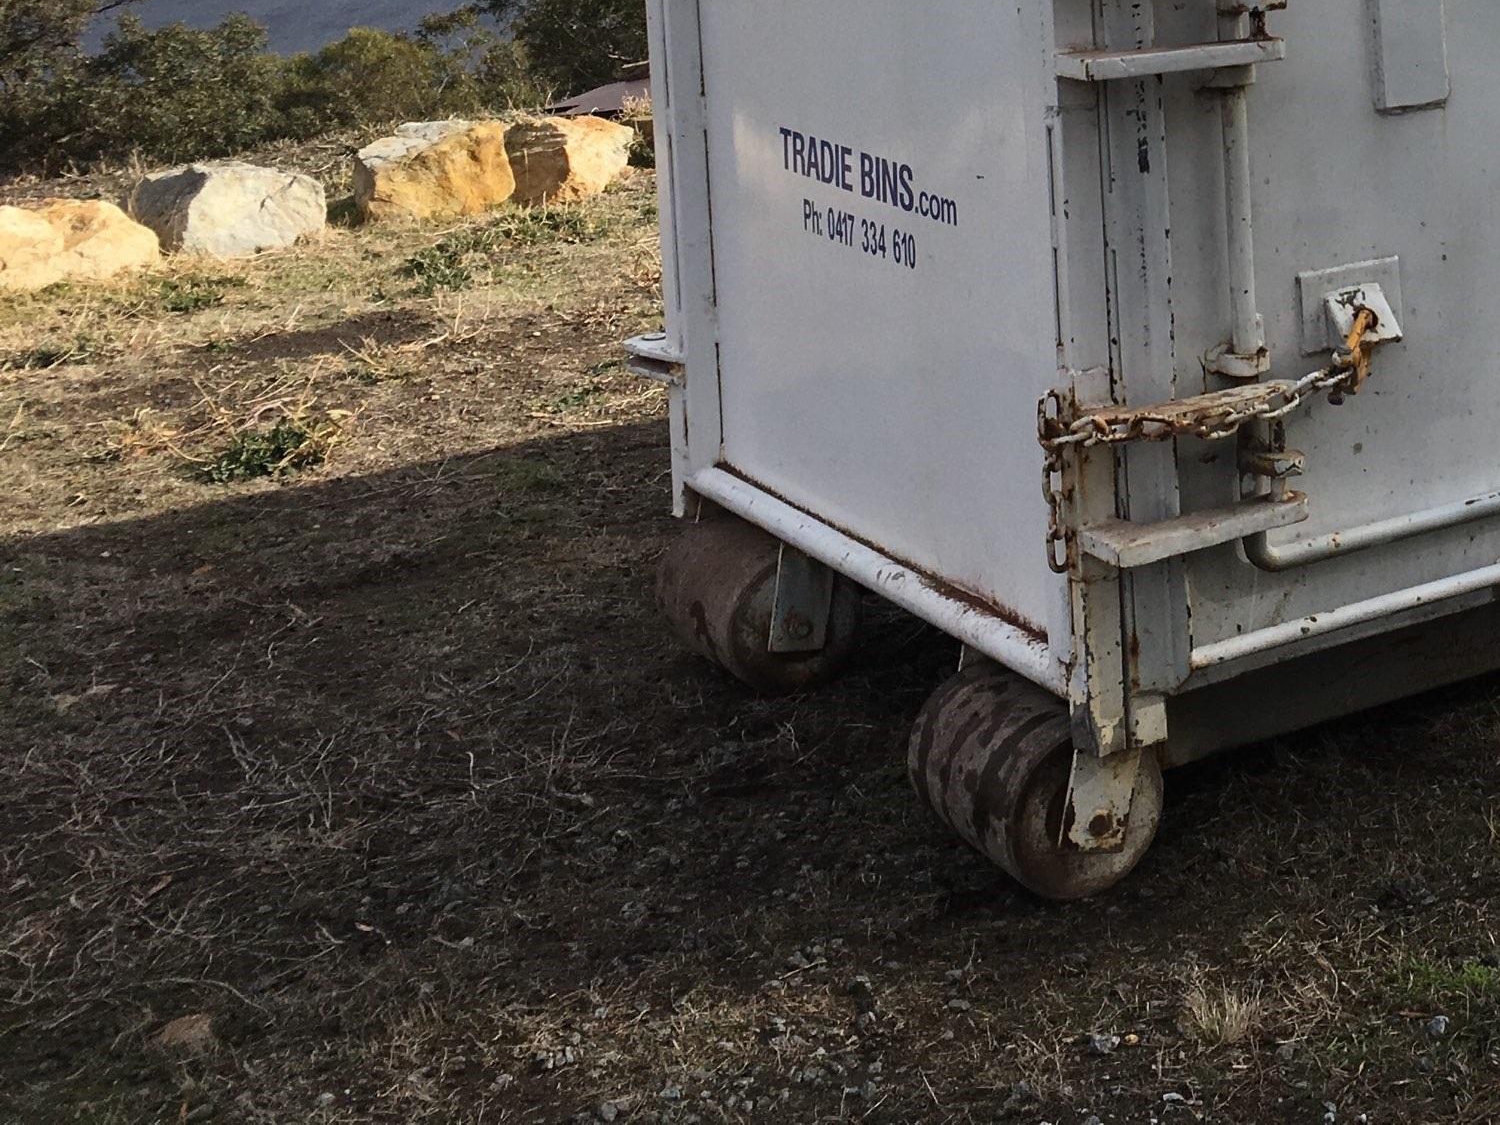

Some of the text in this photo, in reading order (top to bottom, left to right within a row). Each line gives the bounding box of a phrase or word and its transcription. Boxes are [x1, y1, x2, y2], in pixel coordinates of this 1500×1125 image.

[779, 126, 958, 226] TRADIE BINS.com
[803, 198, 916, 270] Ph: 0417 334 610
